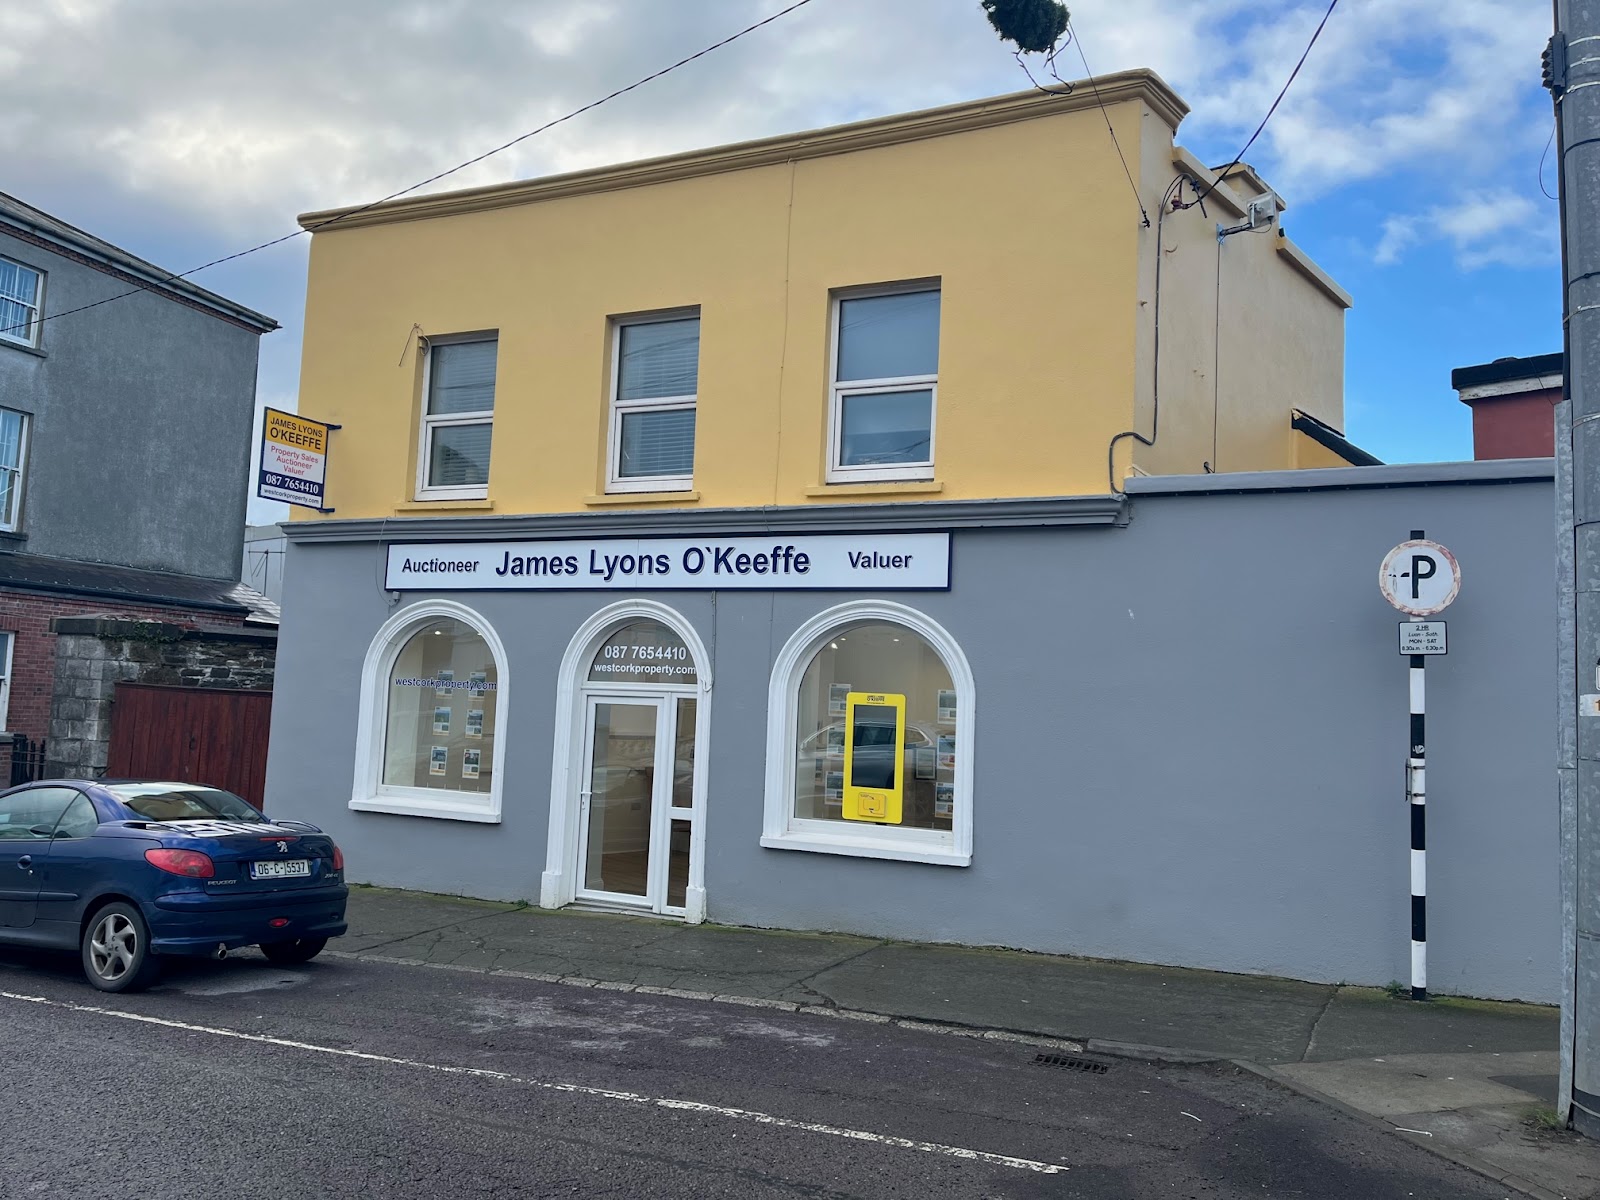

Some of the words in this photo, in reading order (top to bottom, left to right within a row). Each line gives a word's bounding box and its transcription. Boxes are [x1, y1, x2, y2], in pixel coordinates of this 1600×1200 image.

[270, 417, 297, 431] JAMES
[298, 424, 323, 438] LYONS
[270, 427, 322, 450] O'KEEFFE
[270, 445, 299, 459] Property
[301, 453, 319, 464] Sales
[276, 455, 313, 470] Auctioneer
[283, 465, 305, 476] Valuer
[265, 473, 282, 486] 087
[285, 477, 319, 494] 7654410
[263, 487, 320, 504] westcorkproperty.com
[401, 557, 480, 573] Auctioneer
[495, 550, 579, 576] James
[588, 549, 671, 582] Lyons
[848, 550, 913, 570] Valuer
[1412, 555, 1437, 599] P
[604, 645, 628, 659] 087
[631, 645, 687, 660] 7654410
[594, 663, 697, 676] westcorkproperty.com
[394, 676, 498, 692] westcorkproperty.com
